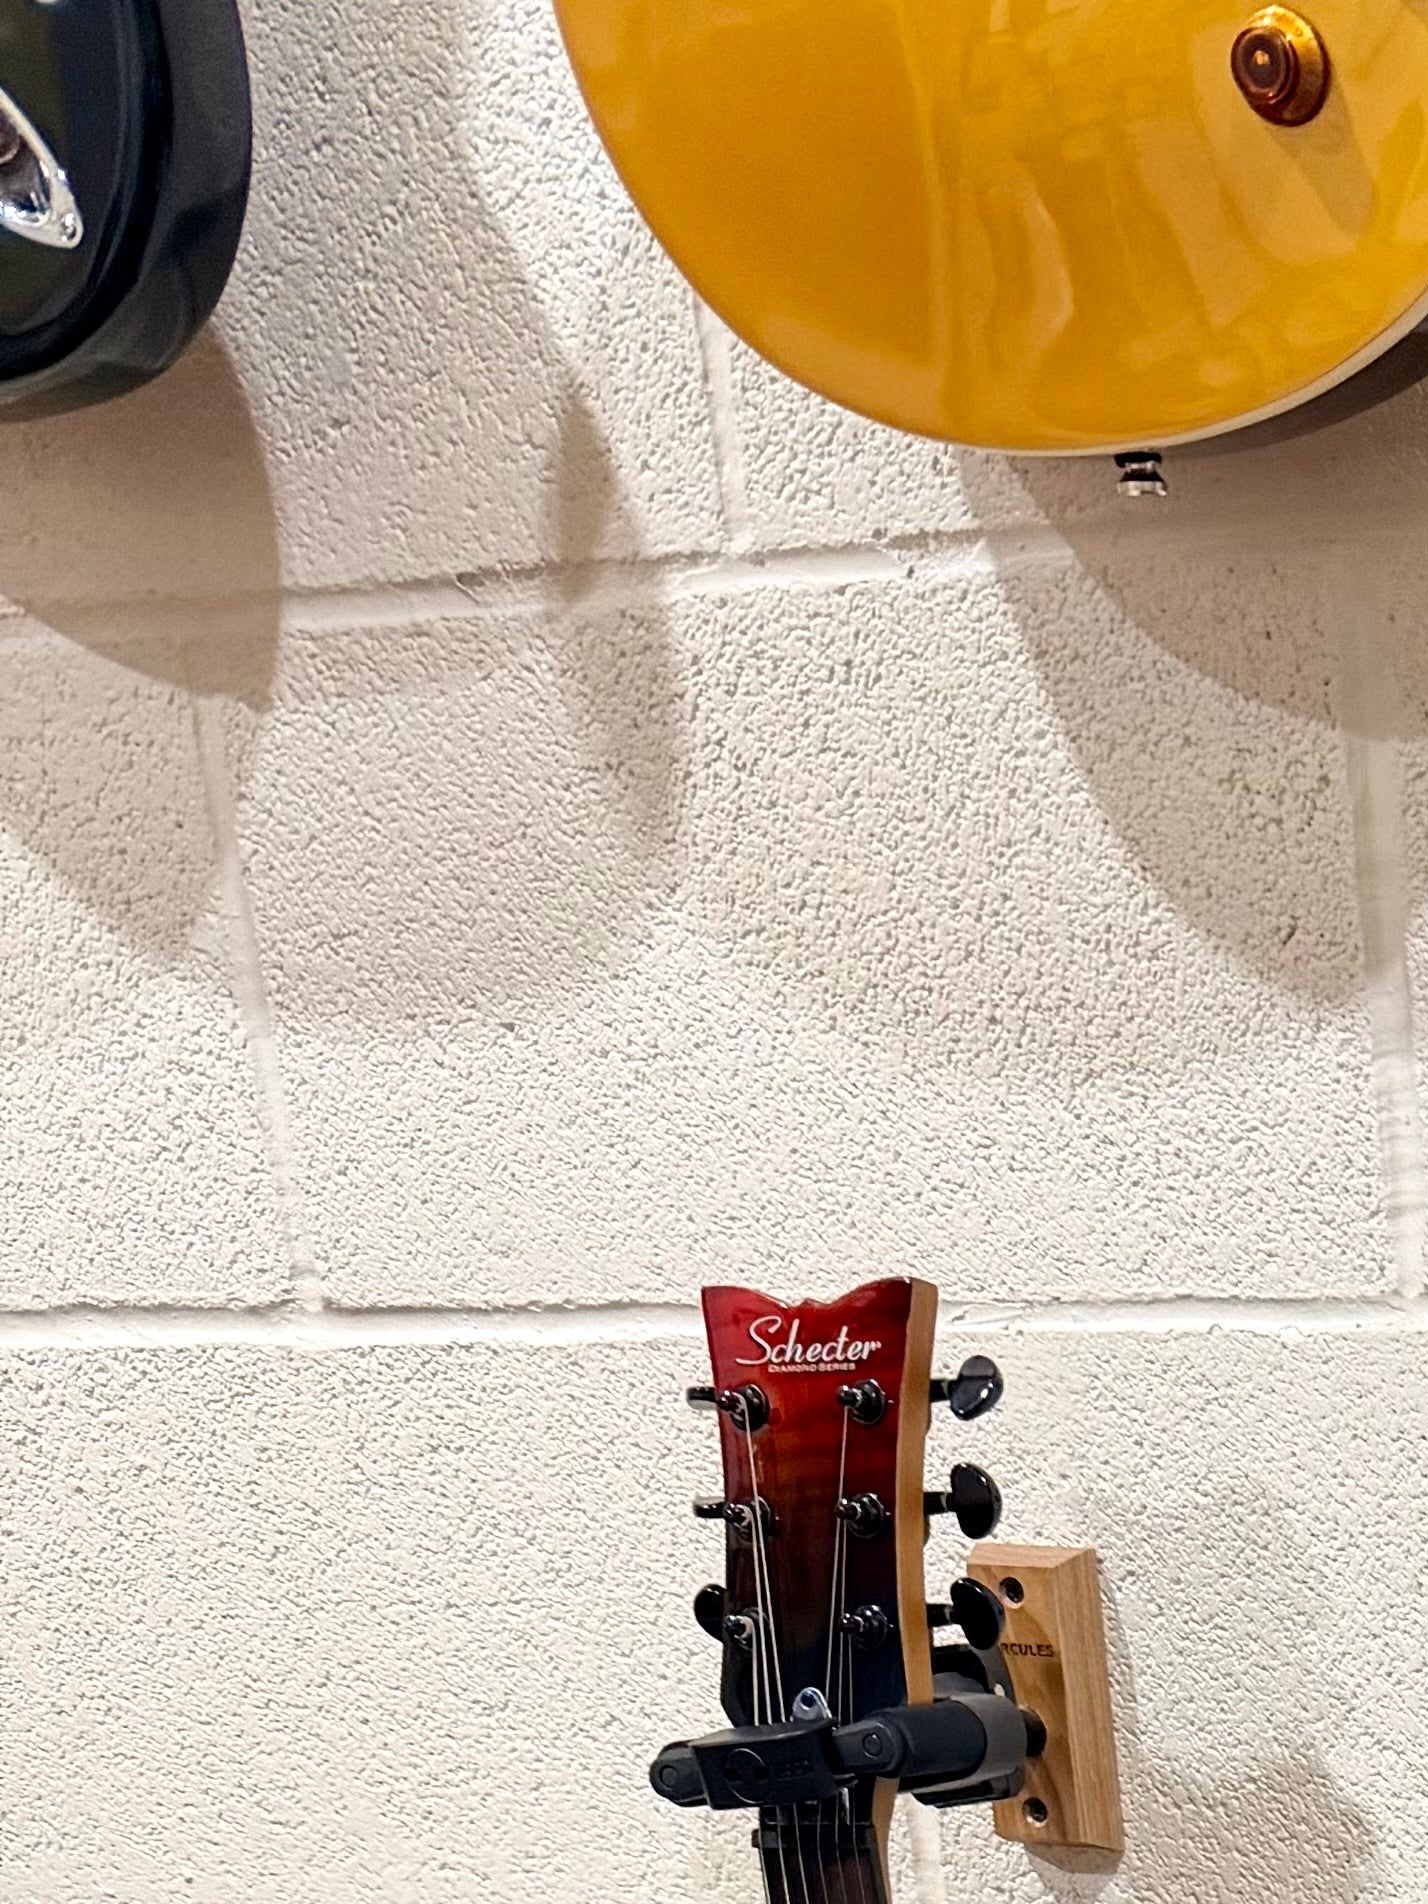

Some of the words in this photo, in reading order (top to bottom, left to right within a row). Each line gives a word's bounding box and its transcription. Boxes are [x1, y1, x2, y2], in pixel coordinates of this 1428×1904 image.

[736, 1315, 882, 1365] Schecter
[767, 1364, 817, 1373] DIAMOND
[818, 1363, 856, 1372] SERIES
